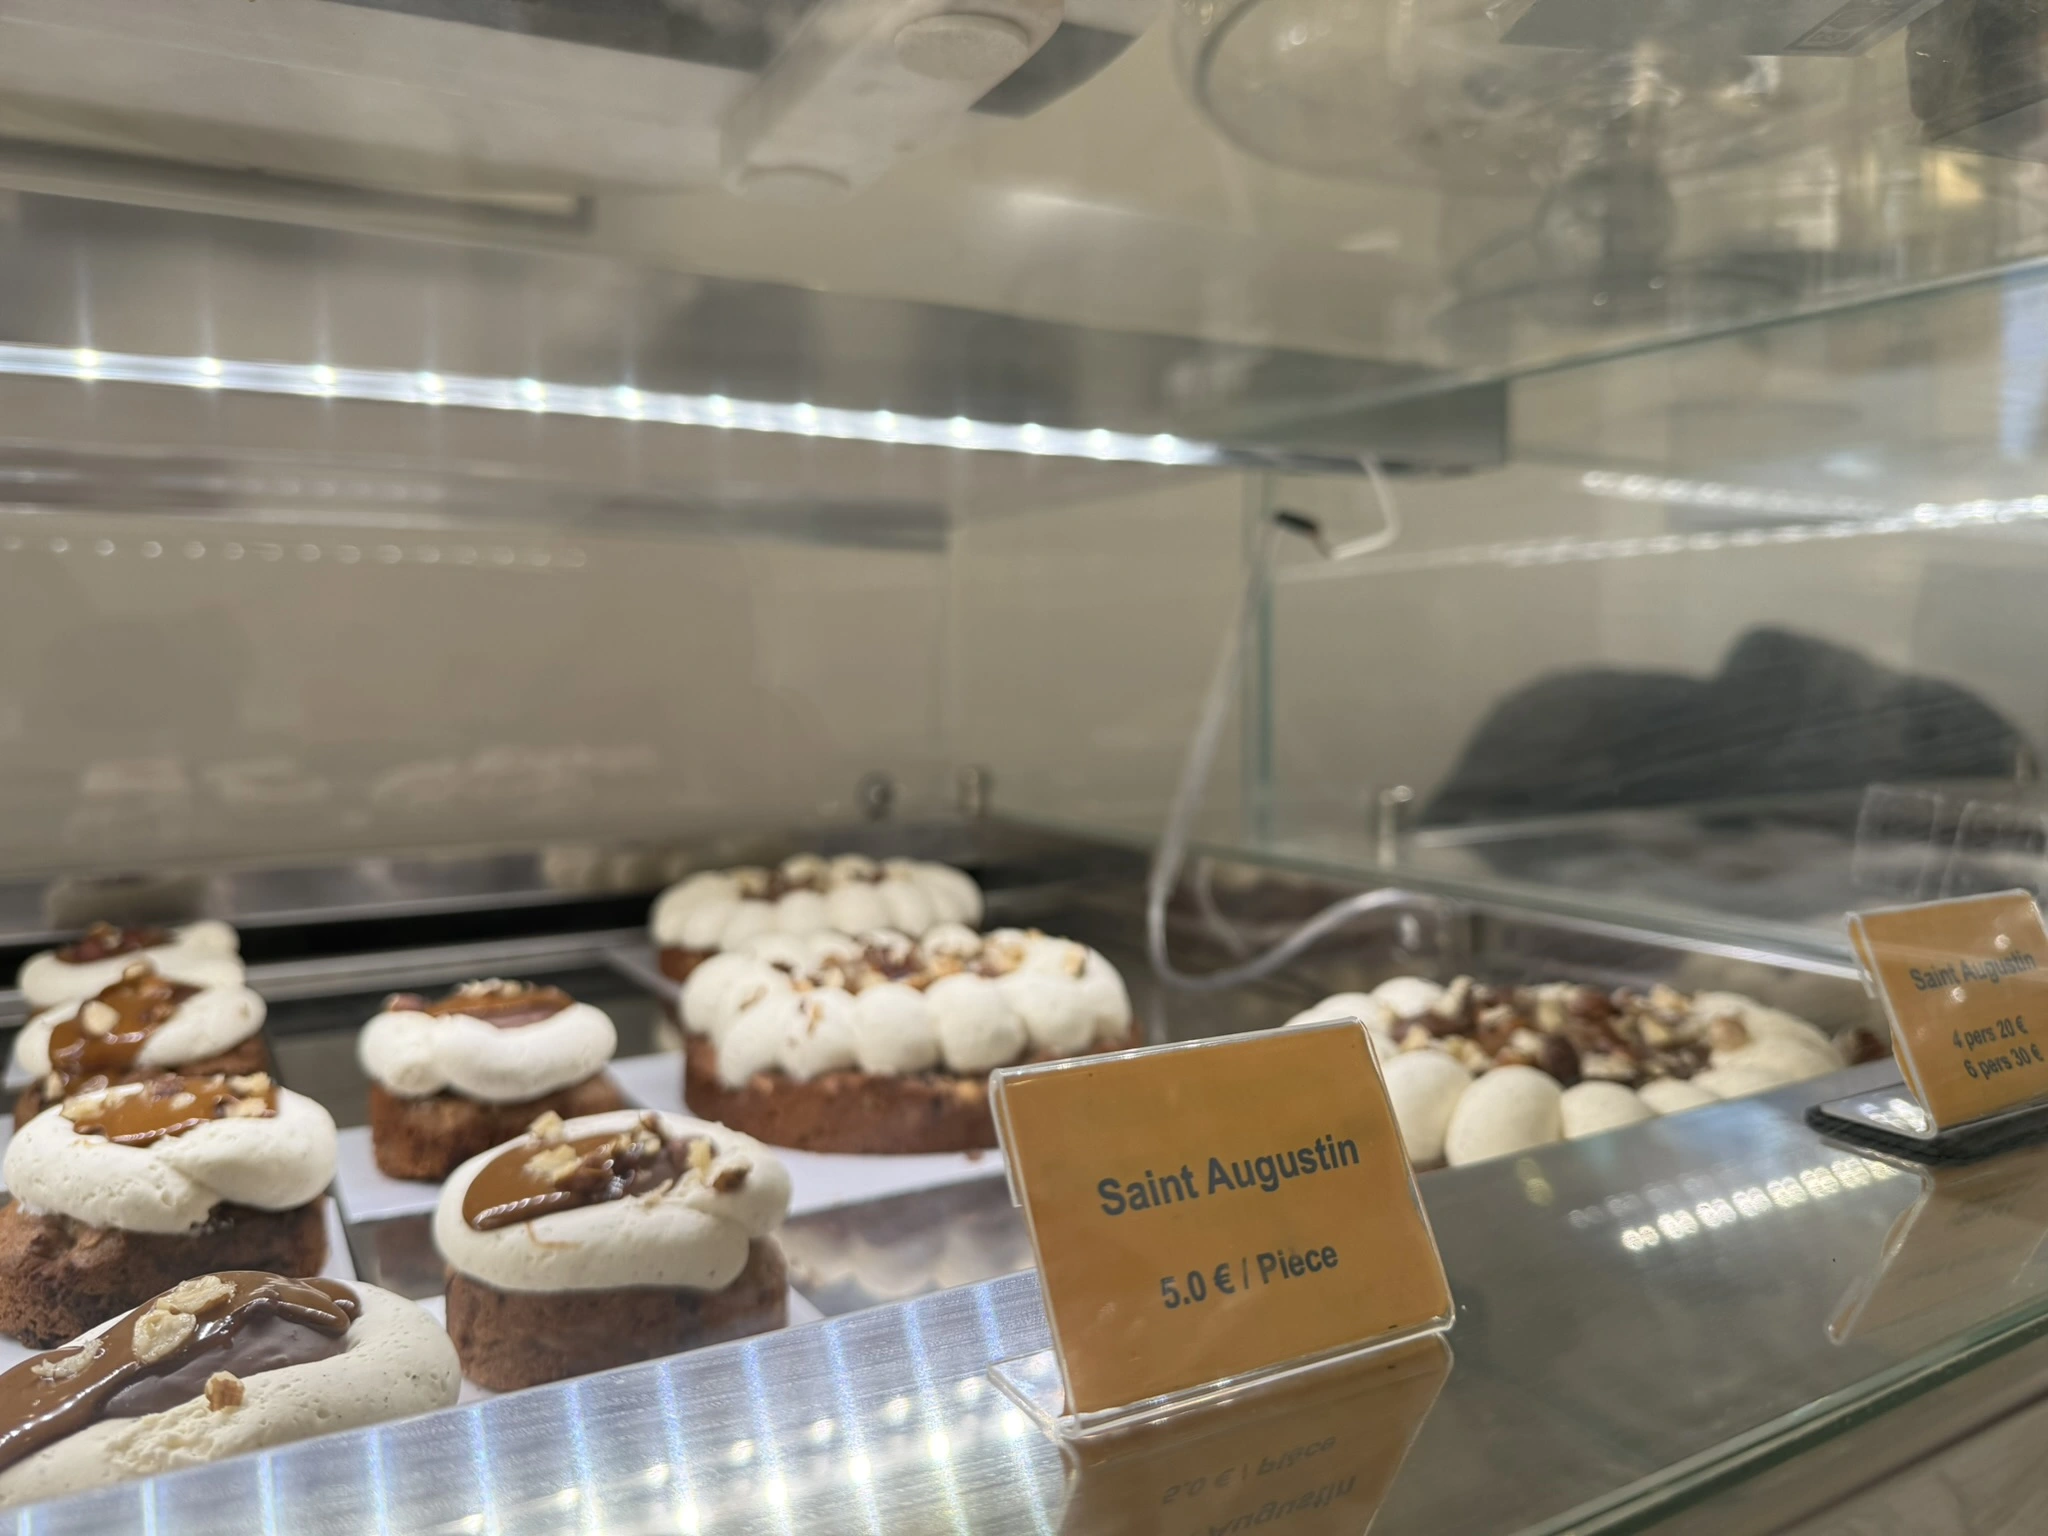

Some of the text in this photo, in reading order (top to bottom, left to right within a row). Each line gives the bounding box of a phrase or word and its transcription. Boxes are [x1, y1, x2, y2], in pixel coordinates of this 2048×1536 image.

[1910, 949, 2036, 991] Saint Augustin
[1953, 1015, 2028, 1051] 4 pers 20 €
[1964, 1042, 2044, 1080] 6 pers 30 €
[1097, 1134, 1360, 1216] Saint Augustin
[1160, 1270, 1207, 1309] 5.0
[1213, 1263, 1236, 1294] €
[1241, 1257, 1250, 1291] /
